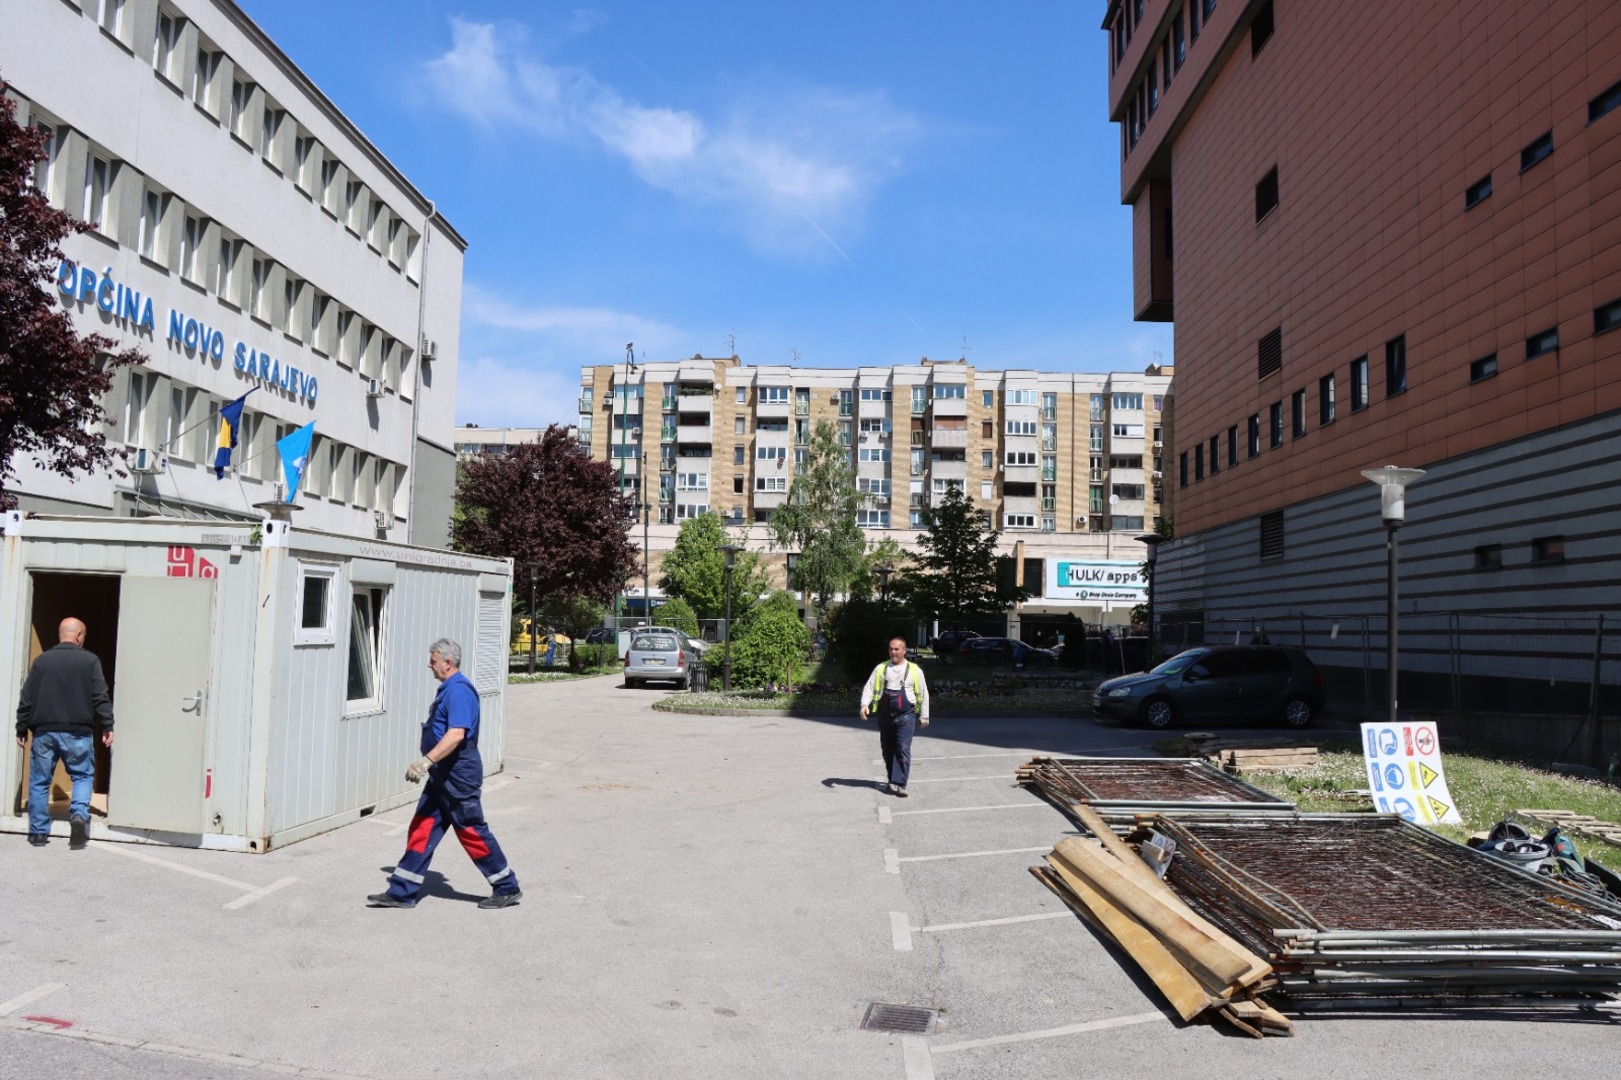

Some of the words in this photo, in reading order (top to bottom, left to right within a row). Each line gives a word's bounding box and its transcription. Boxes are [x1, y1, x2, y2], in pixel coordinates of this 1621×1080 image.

[58, 260, 155, 330] OPĆINA
[167, 308, 225, 361] NOVO
[233, 341, 318, 402] SARAJEVO
[1107, 571, 1138, 584] apps
